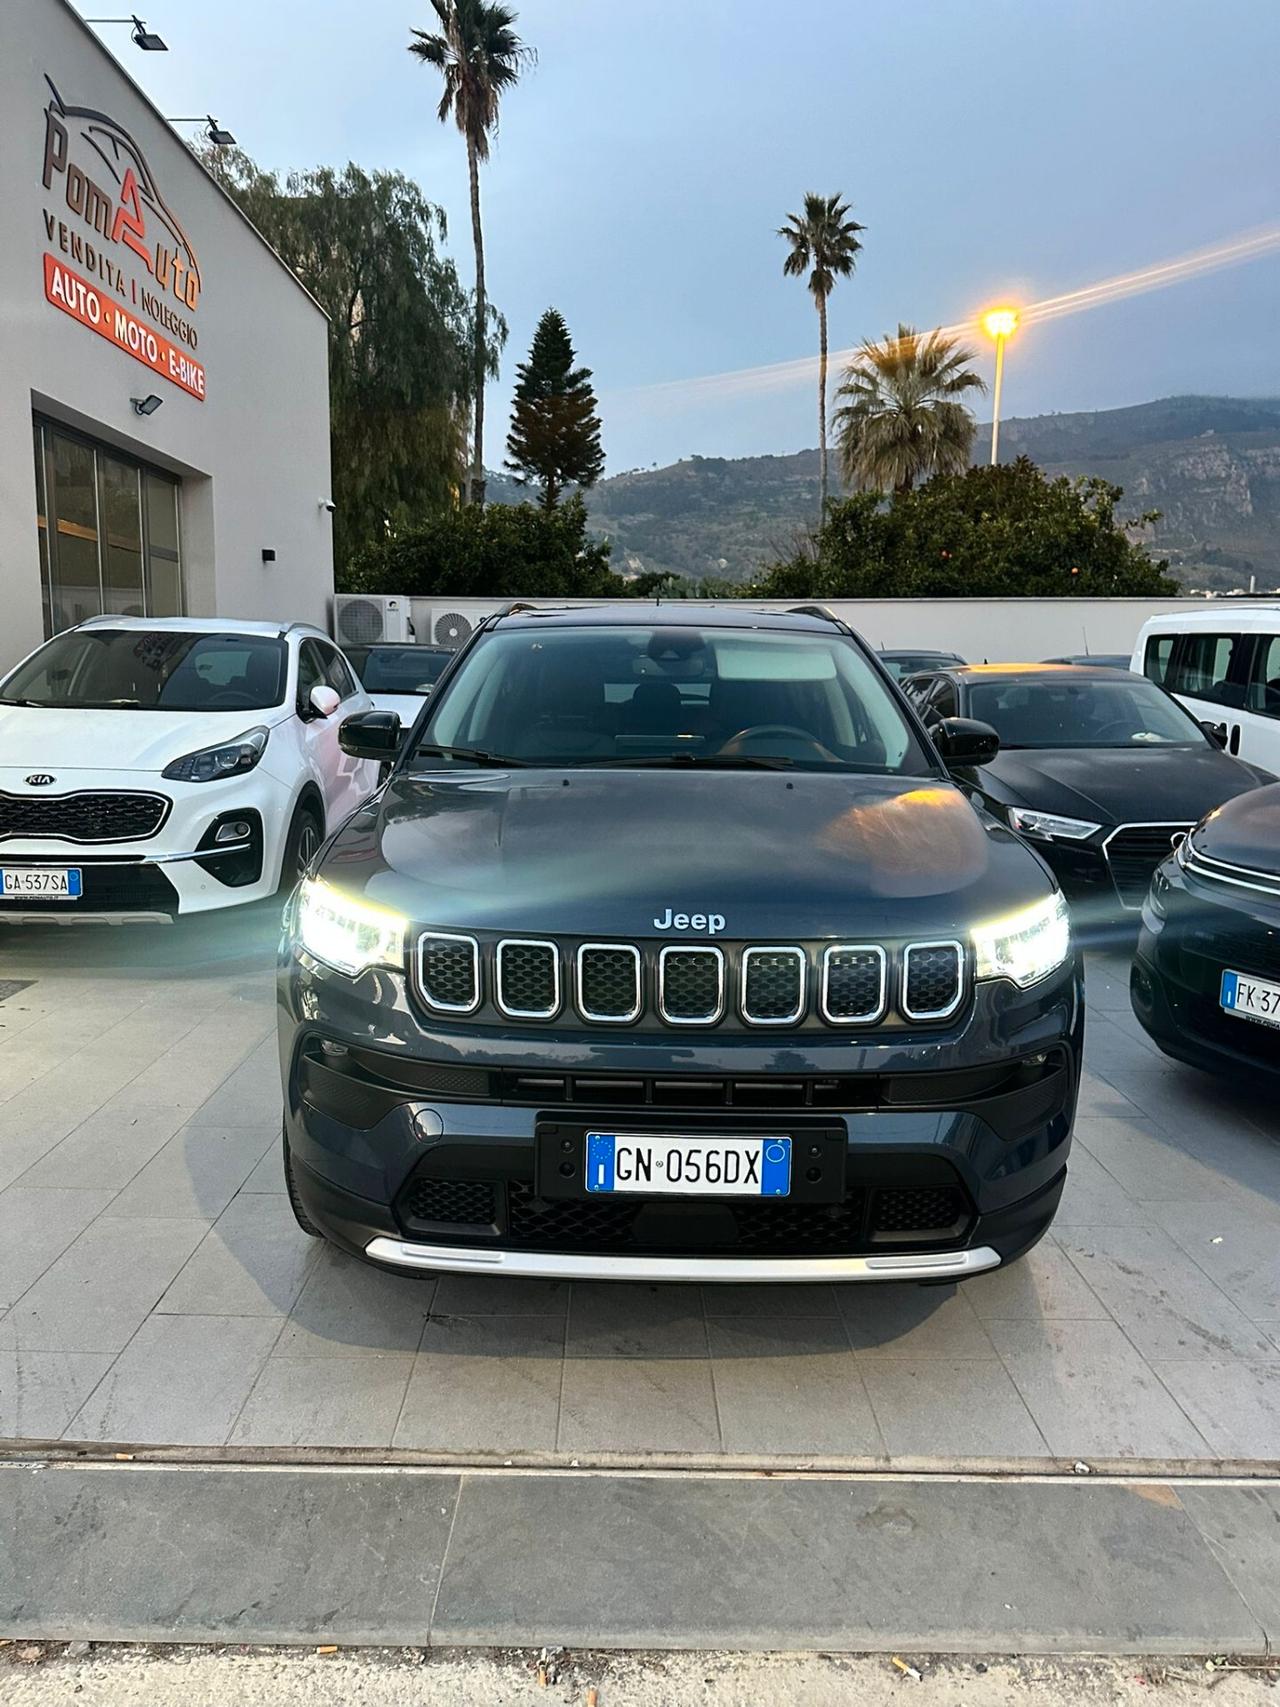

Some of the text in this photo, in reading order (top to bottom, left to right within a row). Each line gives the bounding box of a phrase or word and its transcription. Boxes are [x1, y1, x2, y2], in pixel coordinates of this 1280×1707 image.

[43, 208, 198, 350] VENDITA NOLEGGIO
[52, 266, 204, 395] AUTO MOTO E-BIKE
[28, 775, 51, 784] KIA
[25, 874, 67, 890] 537SA
[653, 908, 726, 934] Jeep
[1237, 982, 1256, 1008] FK
[616, 1148, 760, 1184] GN 056DX
